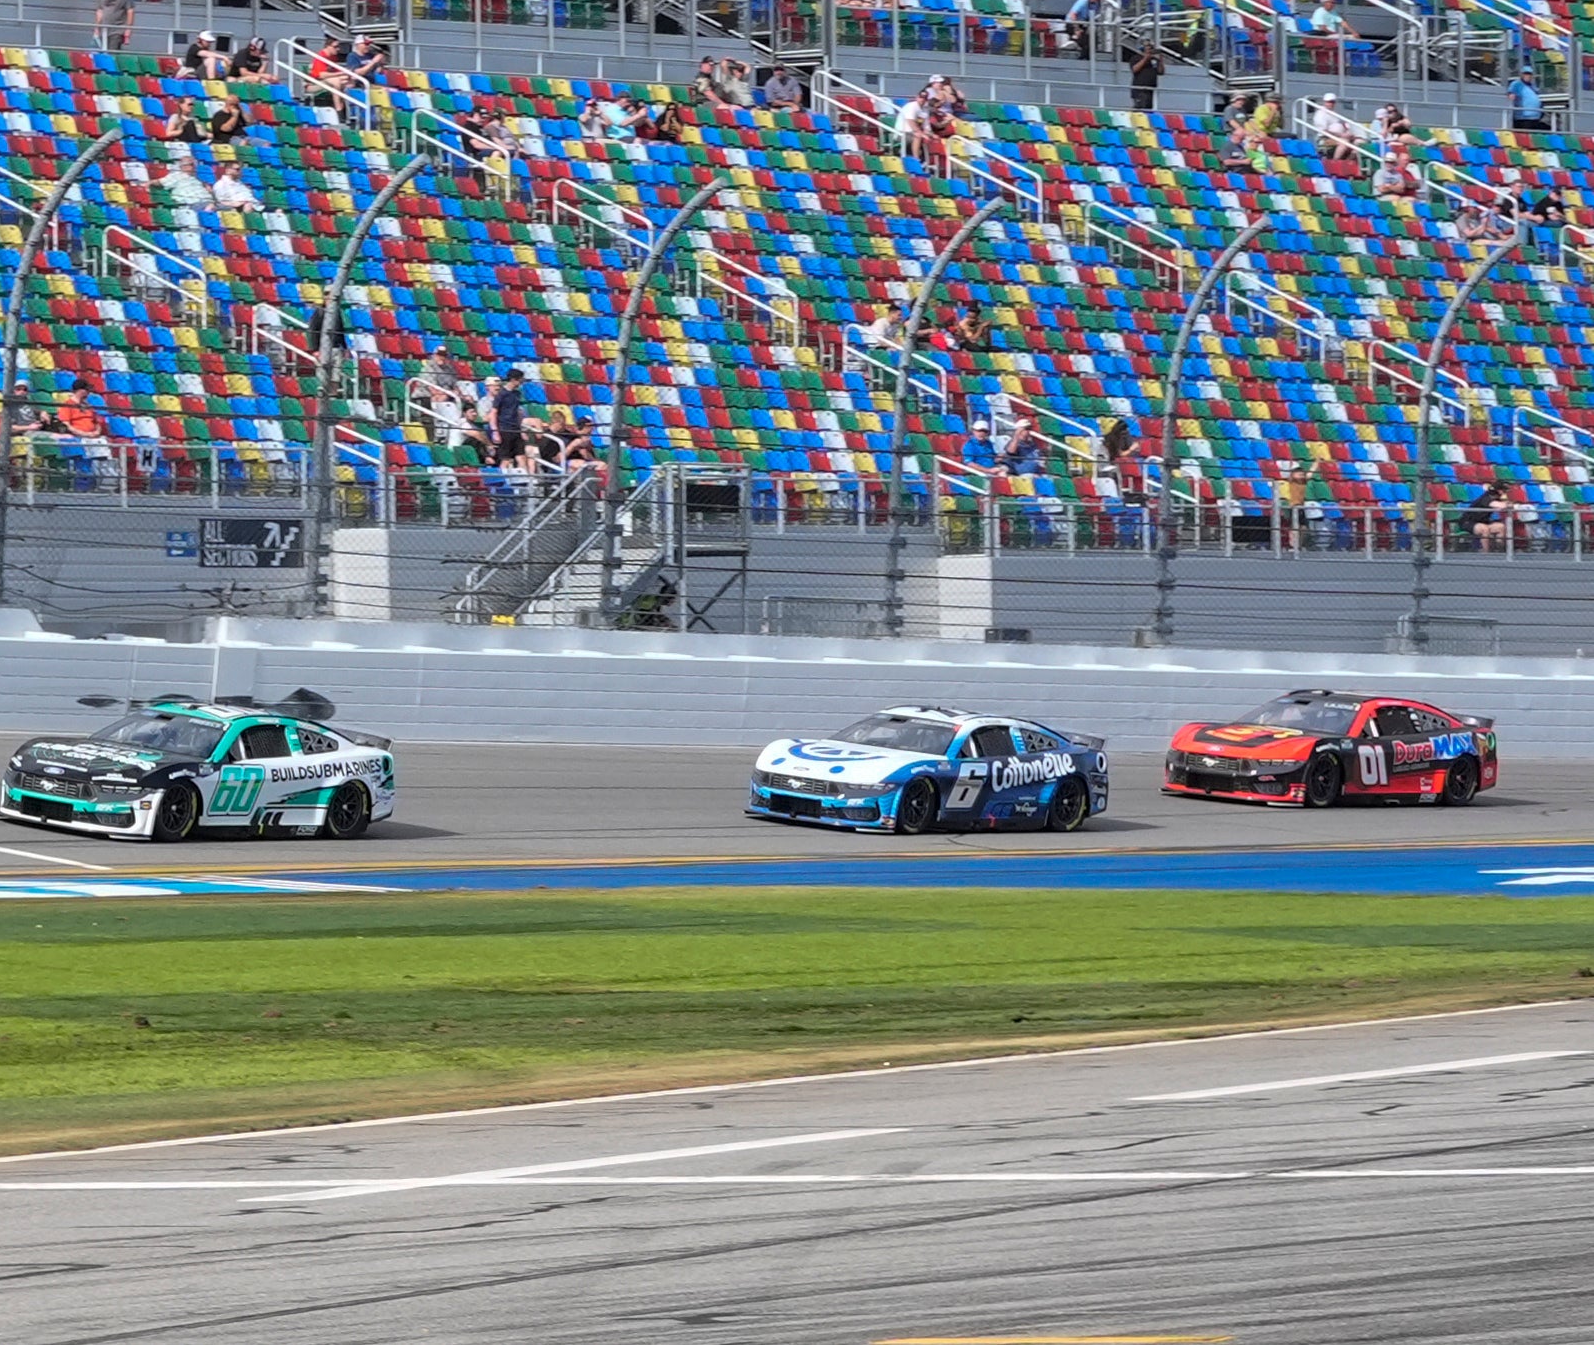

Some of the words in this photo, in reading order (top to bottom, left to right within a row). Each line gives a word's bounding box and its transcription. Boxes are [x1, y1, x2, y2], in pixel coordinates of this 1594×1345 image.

[203, 520, 223, 542] ALL
[1358, 745, 1388, 786] 01
[1392, 731, 1478, 765] DuraMAX
[271, 759, 382, 783] BUILDSUBMARINES
[945, 762, 988, 808] 6
[992, 753, 1076, 792] Cottonelle
[208, 765, 266, 817] 60
